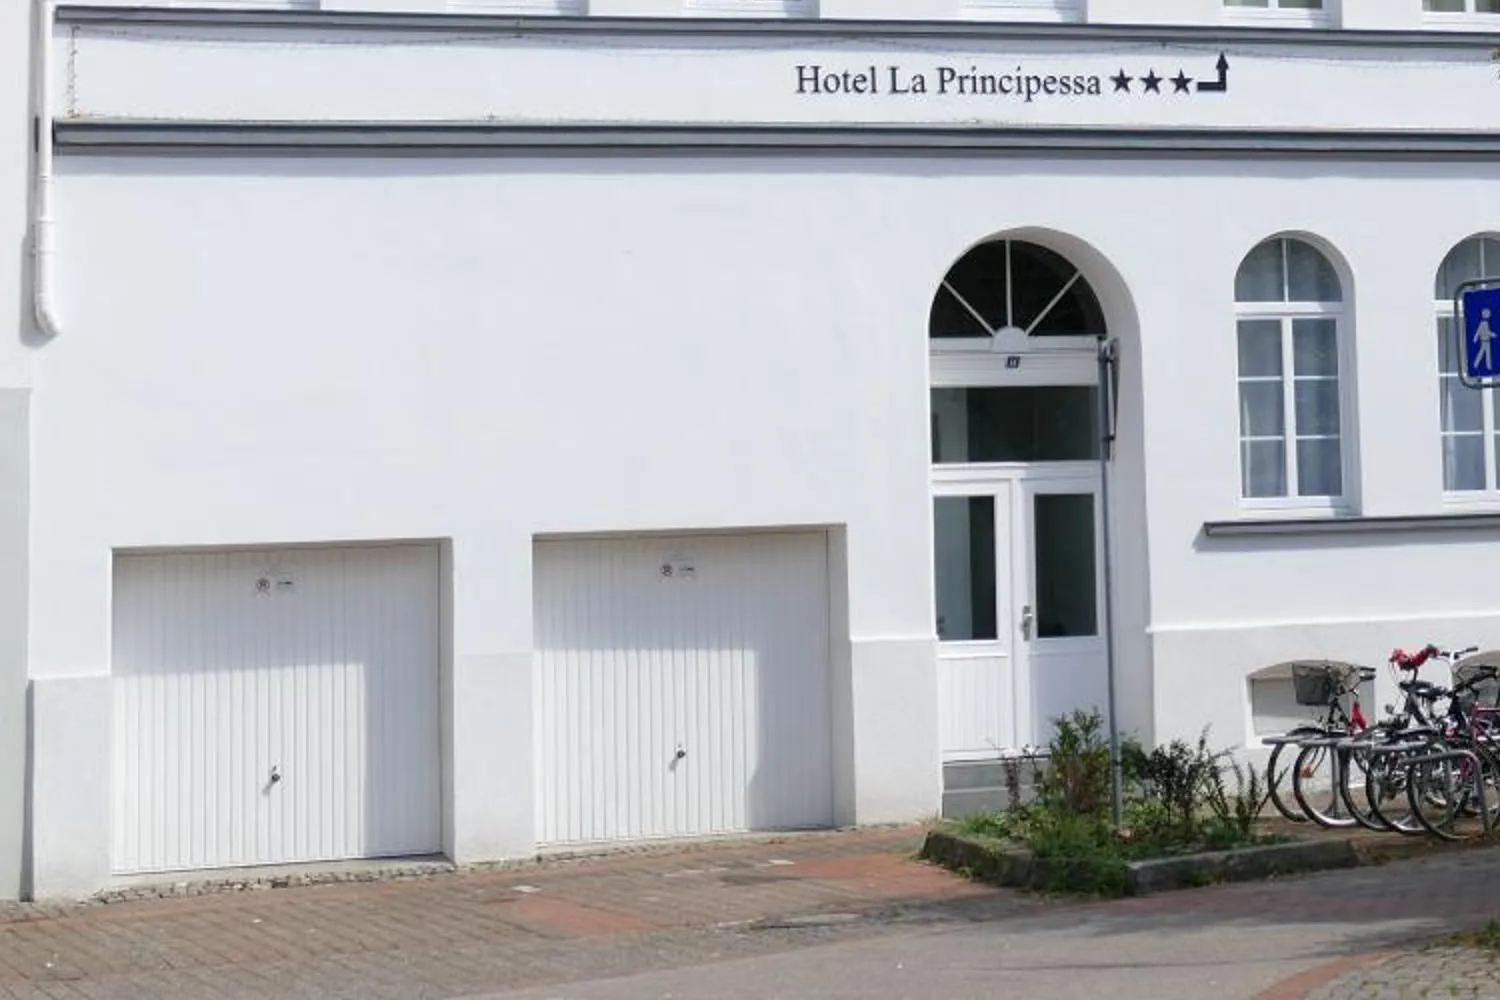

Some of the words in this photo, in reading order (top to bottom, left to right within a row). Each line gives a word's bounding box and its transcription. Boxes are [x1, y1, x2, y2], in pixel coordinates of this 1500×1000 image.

[796, 65, 878, 94] Hotel
[888, 66, 927, 94] La
[936, 66, 1101, 102] Principessa
